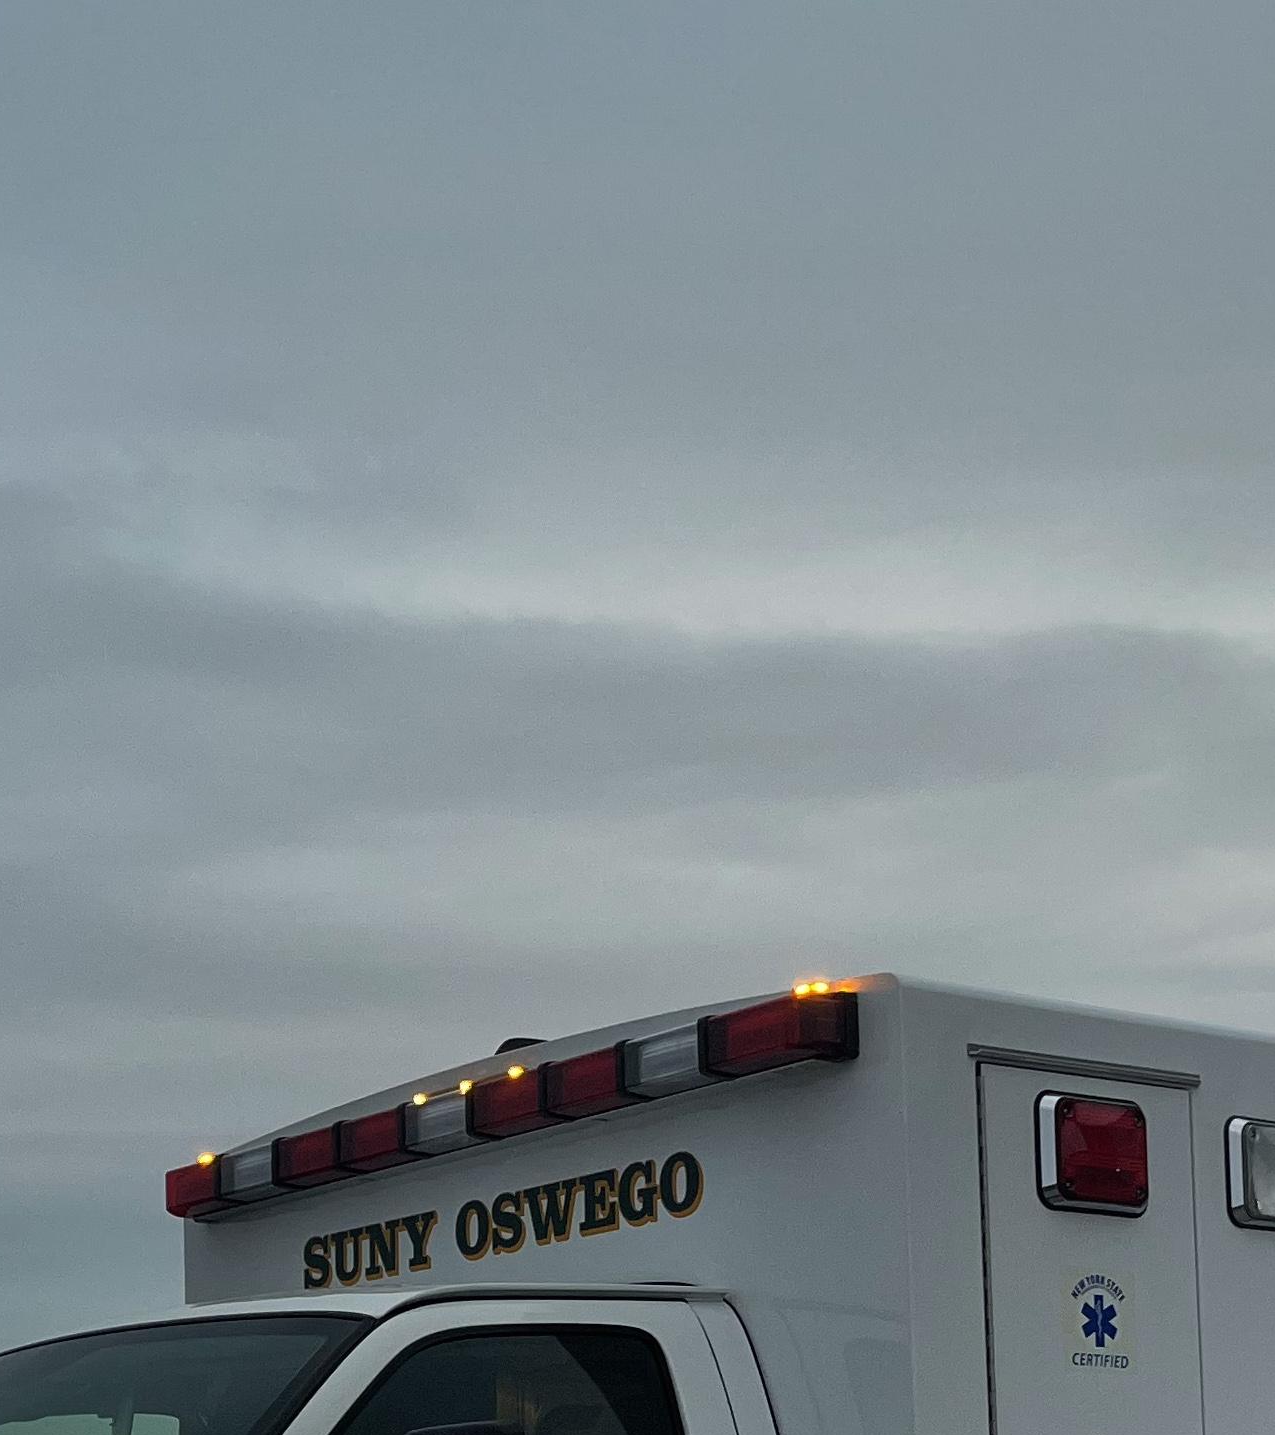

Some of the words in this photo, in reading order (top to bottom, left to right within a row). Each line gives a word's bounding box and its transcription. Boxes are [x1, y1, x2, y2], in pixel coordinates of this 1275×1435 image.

[303, 1210, 438, 1291] SUNY
[455, 1151, 705, 1261] OSWEGO
[1071, 1352, 1129, 1369] CERTIFIED
